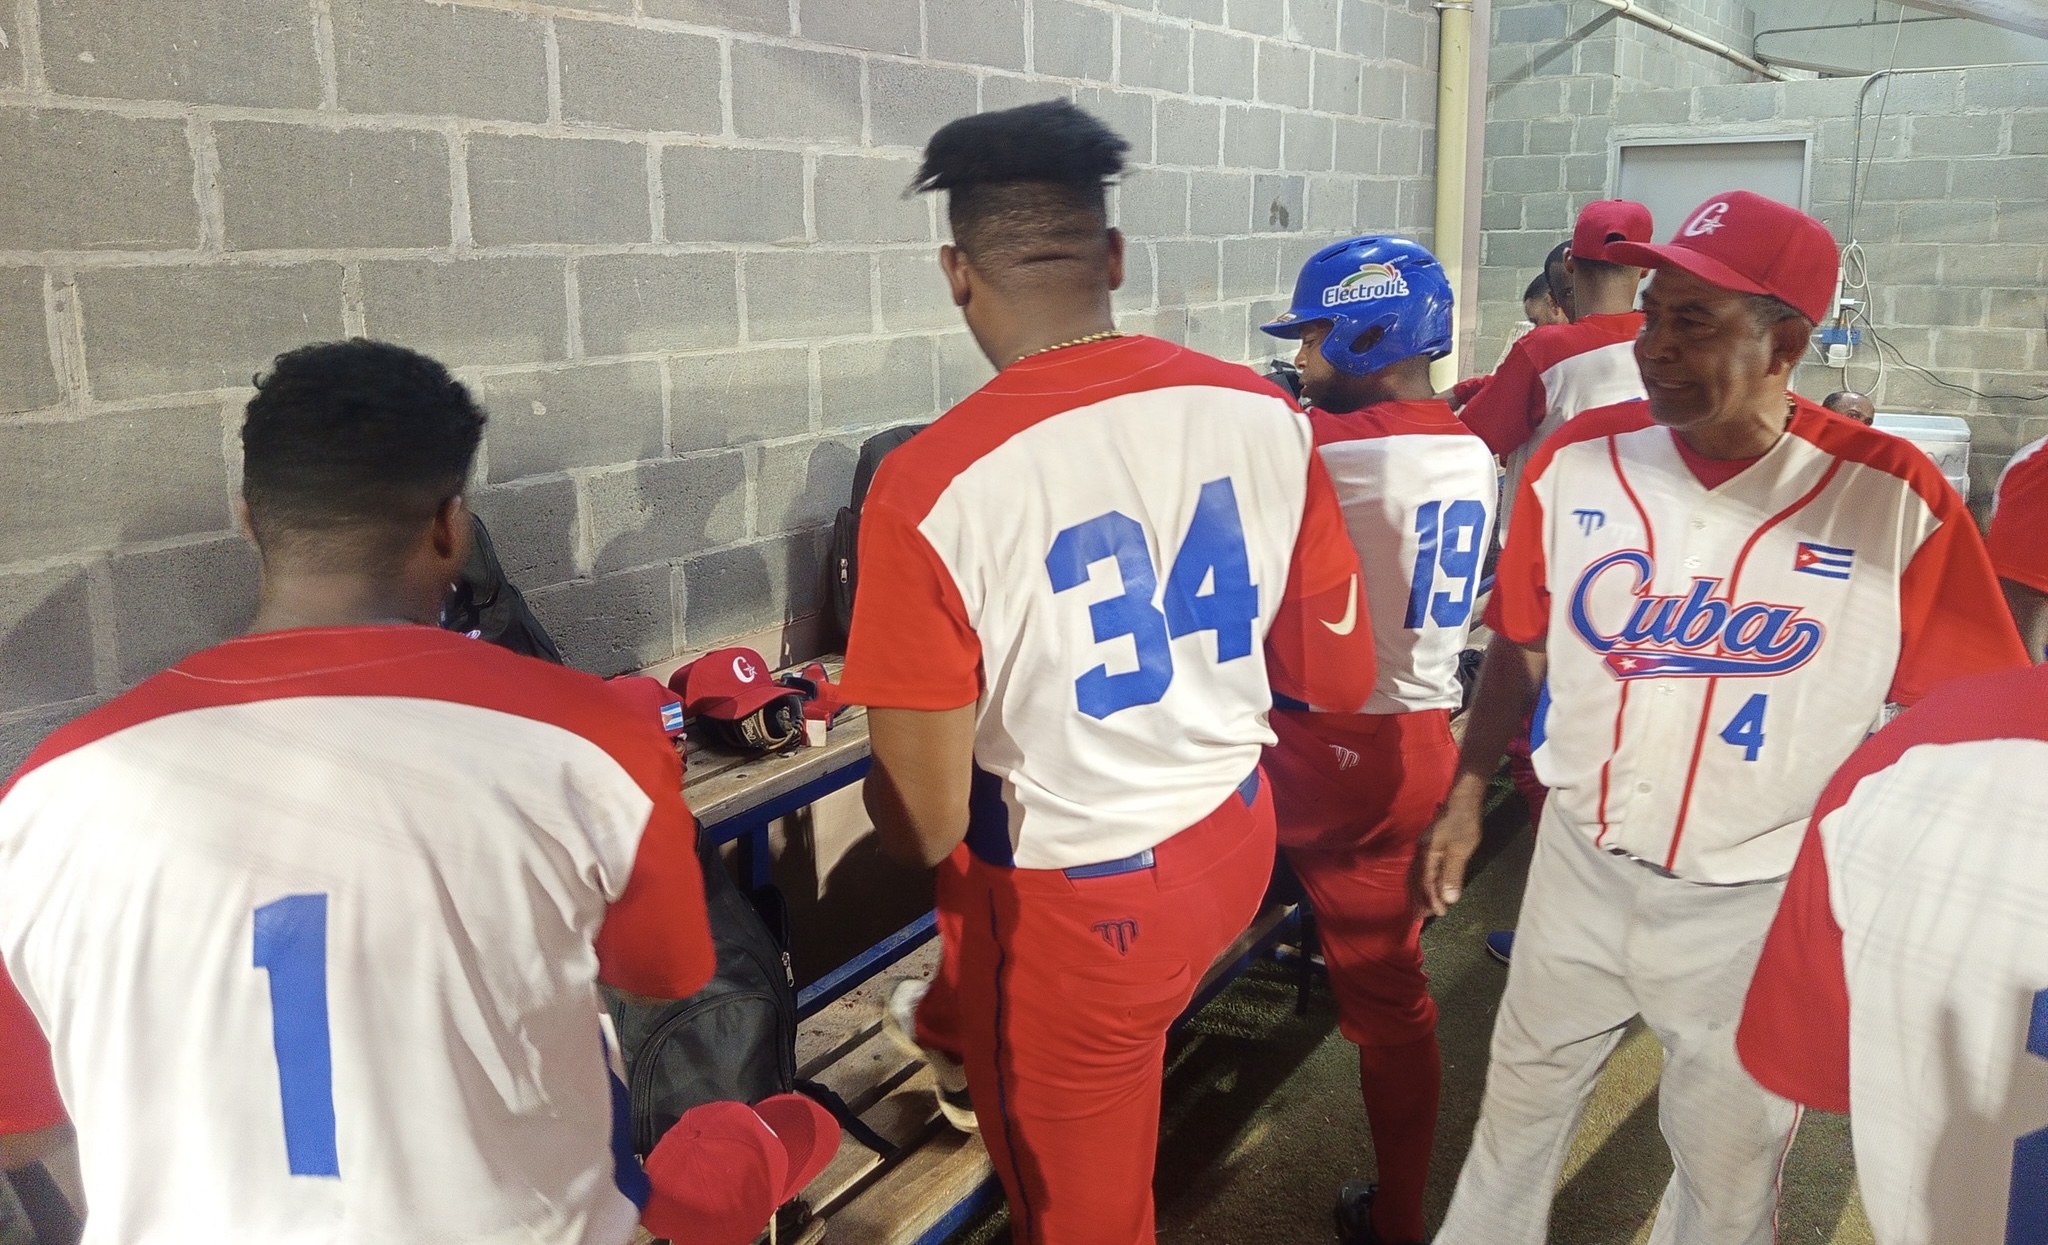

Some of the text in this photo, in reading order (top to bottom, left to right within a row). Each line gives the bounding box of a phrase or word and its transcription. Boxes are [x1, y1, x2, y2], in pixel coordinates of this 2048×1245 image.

[1324, 280, 1405, 304] Electrolit
[1045, 476, 1258, 720] 34
[1403, 500, 1487, 629] 19
[1567, 548, 1826, 680] Cuba
[1719, 693, 1769, 761] 4
[253, 892, 341, 1179] 1
